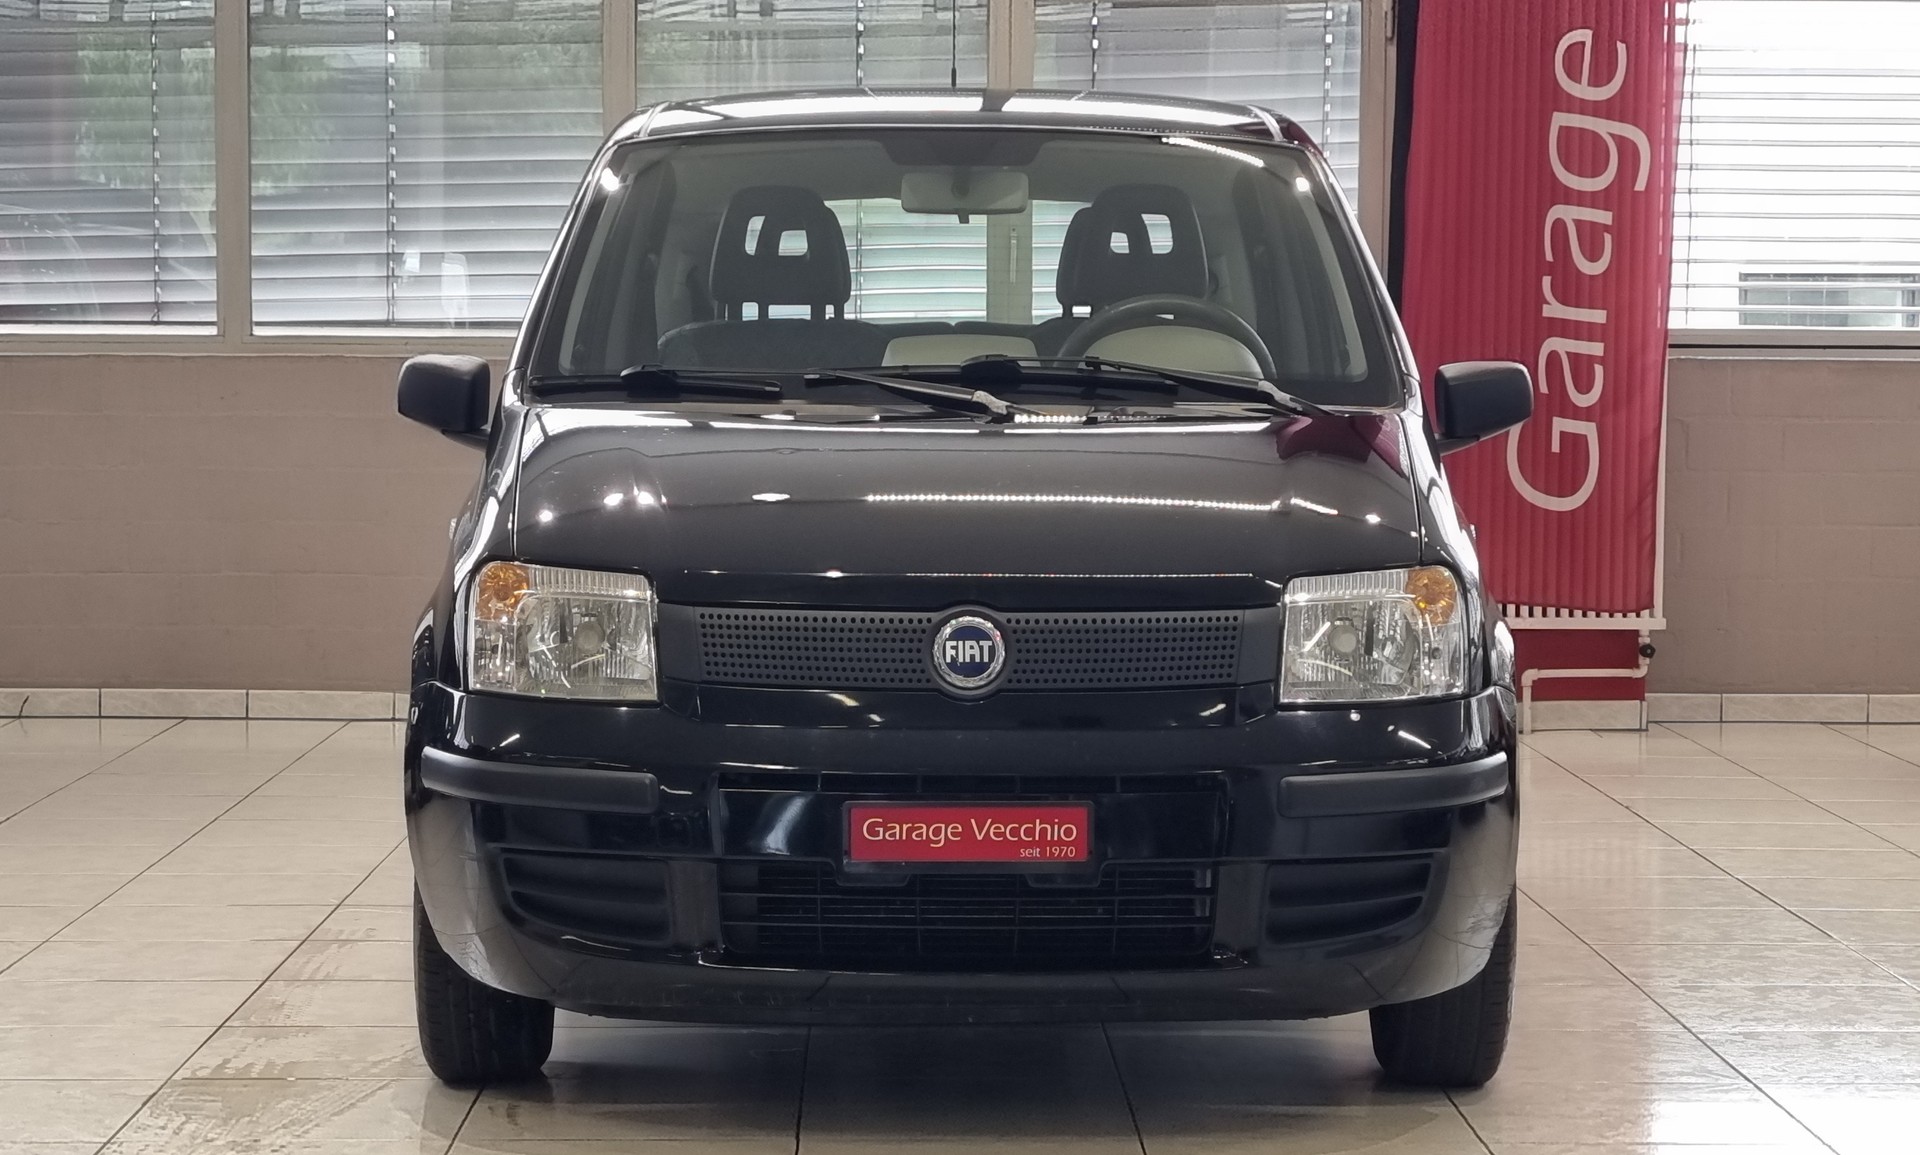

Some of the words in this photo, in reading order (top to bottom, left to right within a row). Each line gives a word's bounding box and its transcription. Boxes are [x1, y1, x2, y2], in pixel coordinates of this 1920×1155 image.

[1507, 28, 1651, 512] Garage
[945, 640, 993, 663] FIAT
[862, 818, 962, 847] Garage
[970, 818, 1077, 841] Vecchio
[1019, 846, 1041, 857] seit
[1045, 846, 1076, 857] 1970
